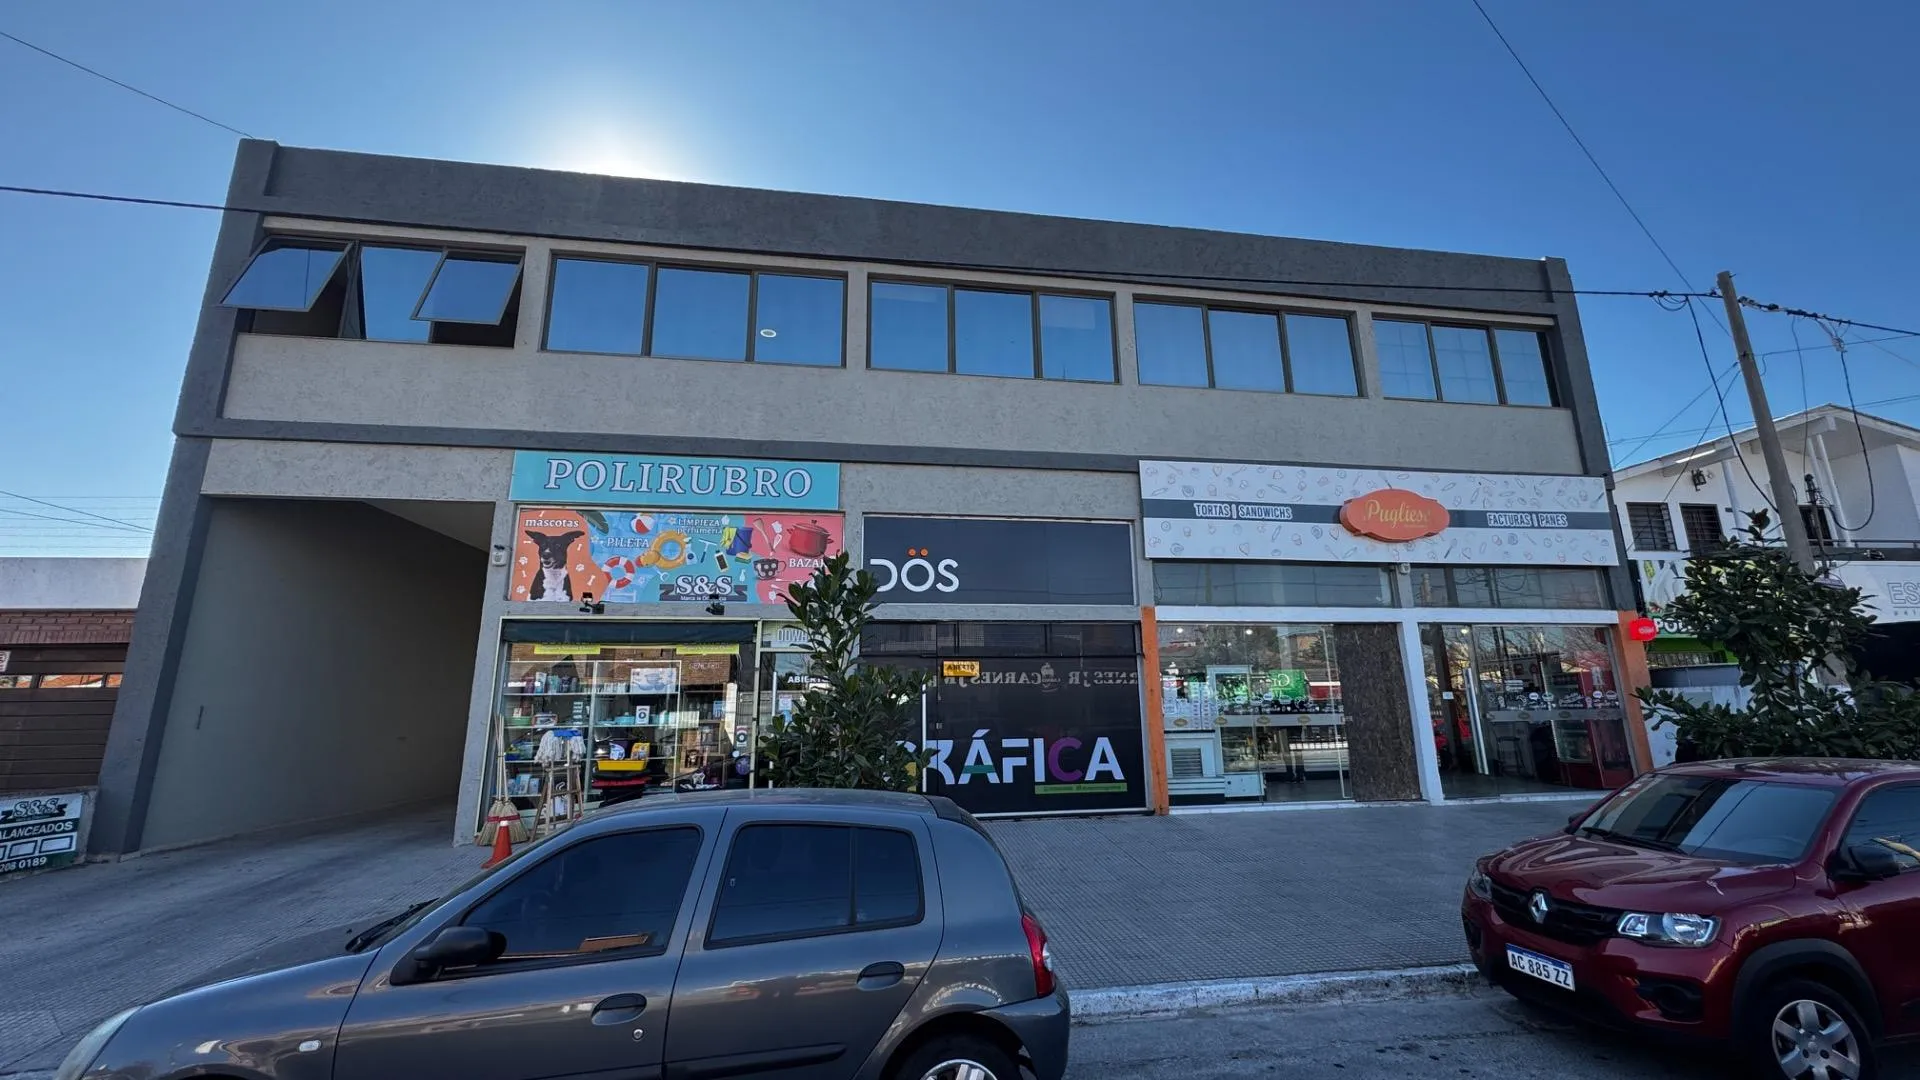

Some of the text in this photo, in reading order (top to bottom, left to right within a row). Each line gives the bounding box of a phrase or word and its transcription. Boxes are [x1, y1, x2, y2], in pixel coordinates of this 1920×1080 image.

[545, 458, 813, 499] POLIRUBRO
[1193, 503, 1293, 520] TORTAS SANDWICHS
[1486, 512, 1568, 528] FACTURAS PANES
[525, 519, 579, 528] mascotas
[678, 518, 720, 526] LIMPIEZA
[607, 537, 650, 548] PILETA
[676, 575, 732, 595] S&S
[1887, 581, 1920, 605] ES
[896, 728, 1125, 788] RÁFICA
[14, 797, 60, 818] S&S
[18, 856, 48, 869] 0189
[1511, 953, 1525, 970] AC
[1528, 959, 1551, 979] 885
[1552, 967, 1571, 987] ZZ
